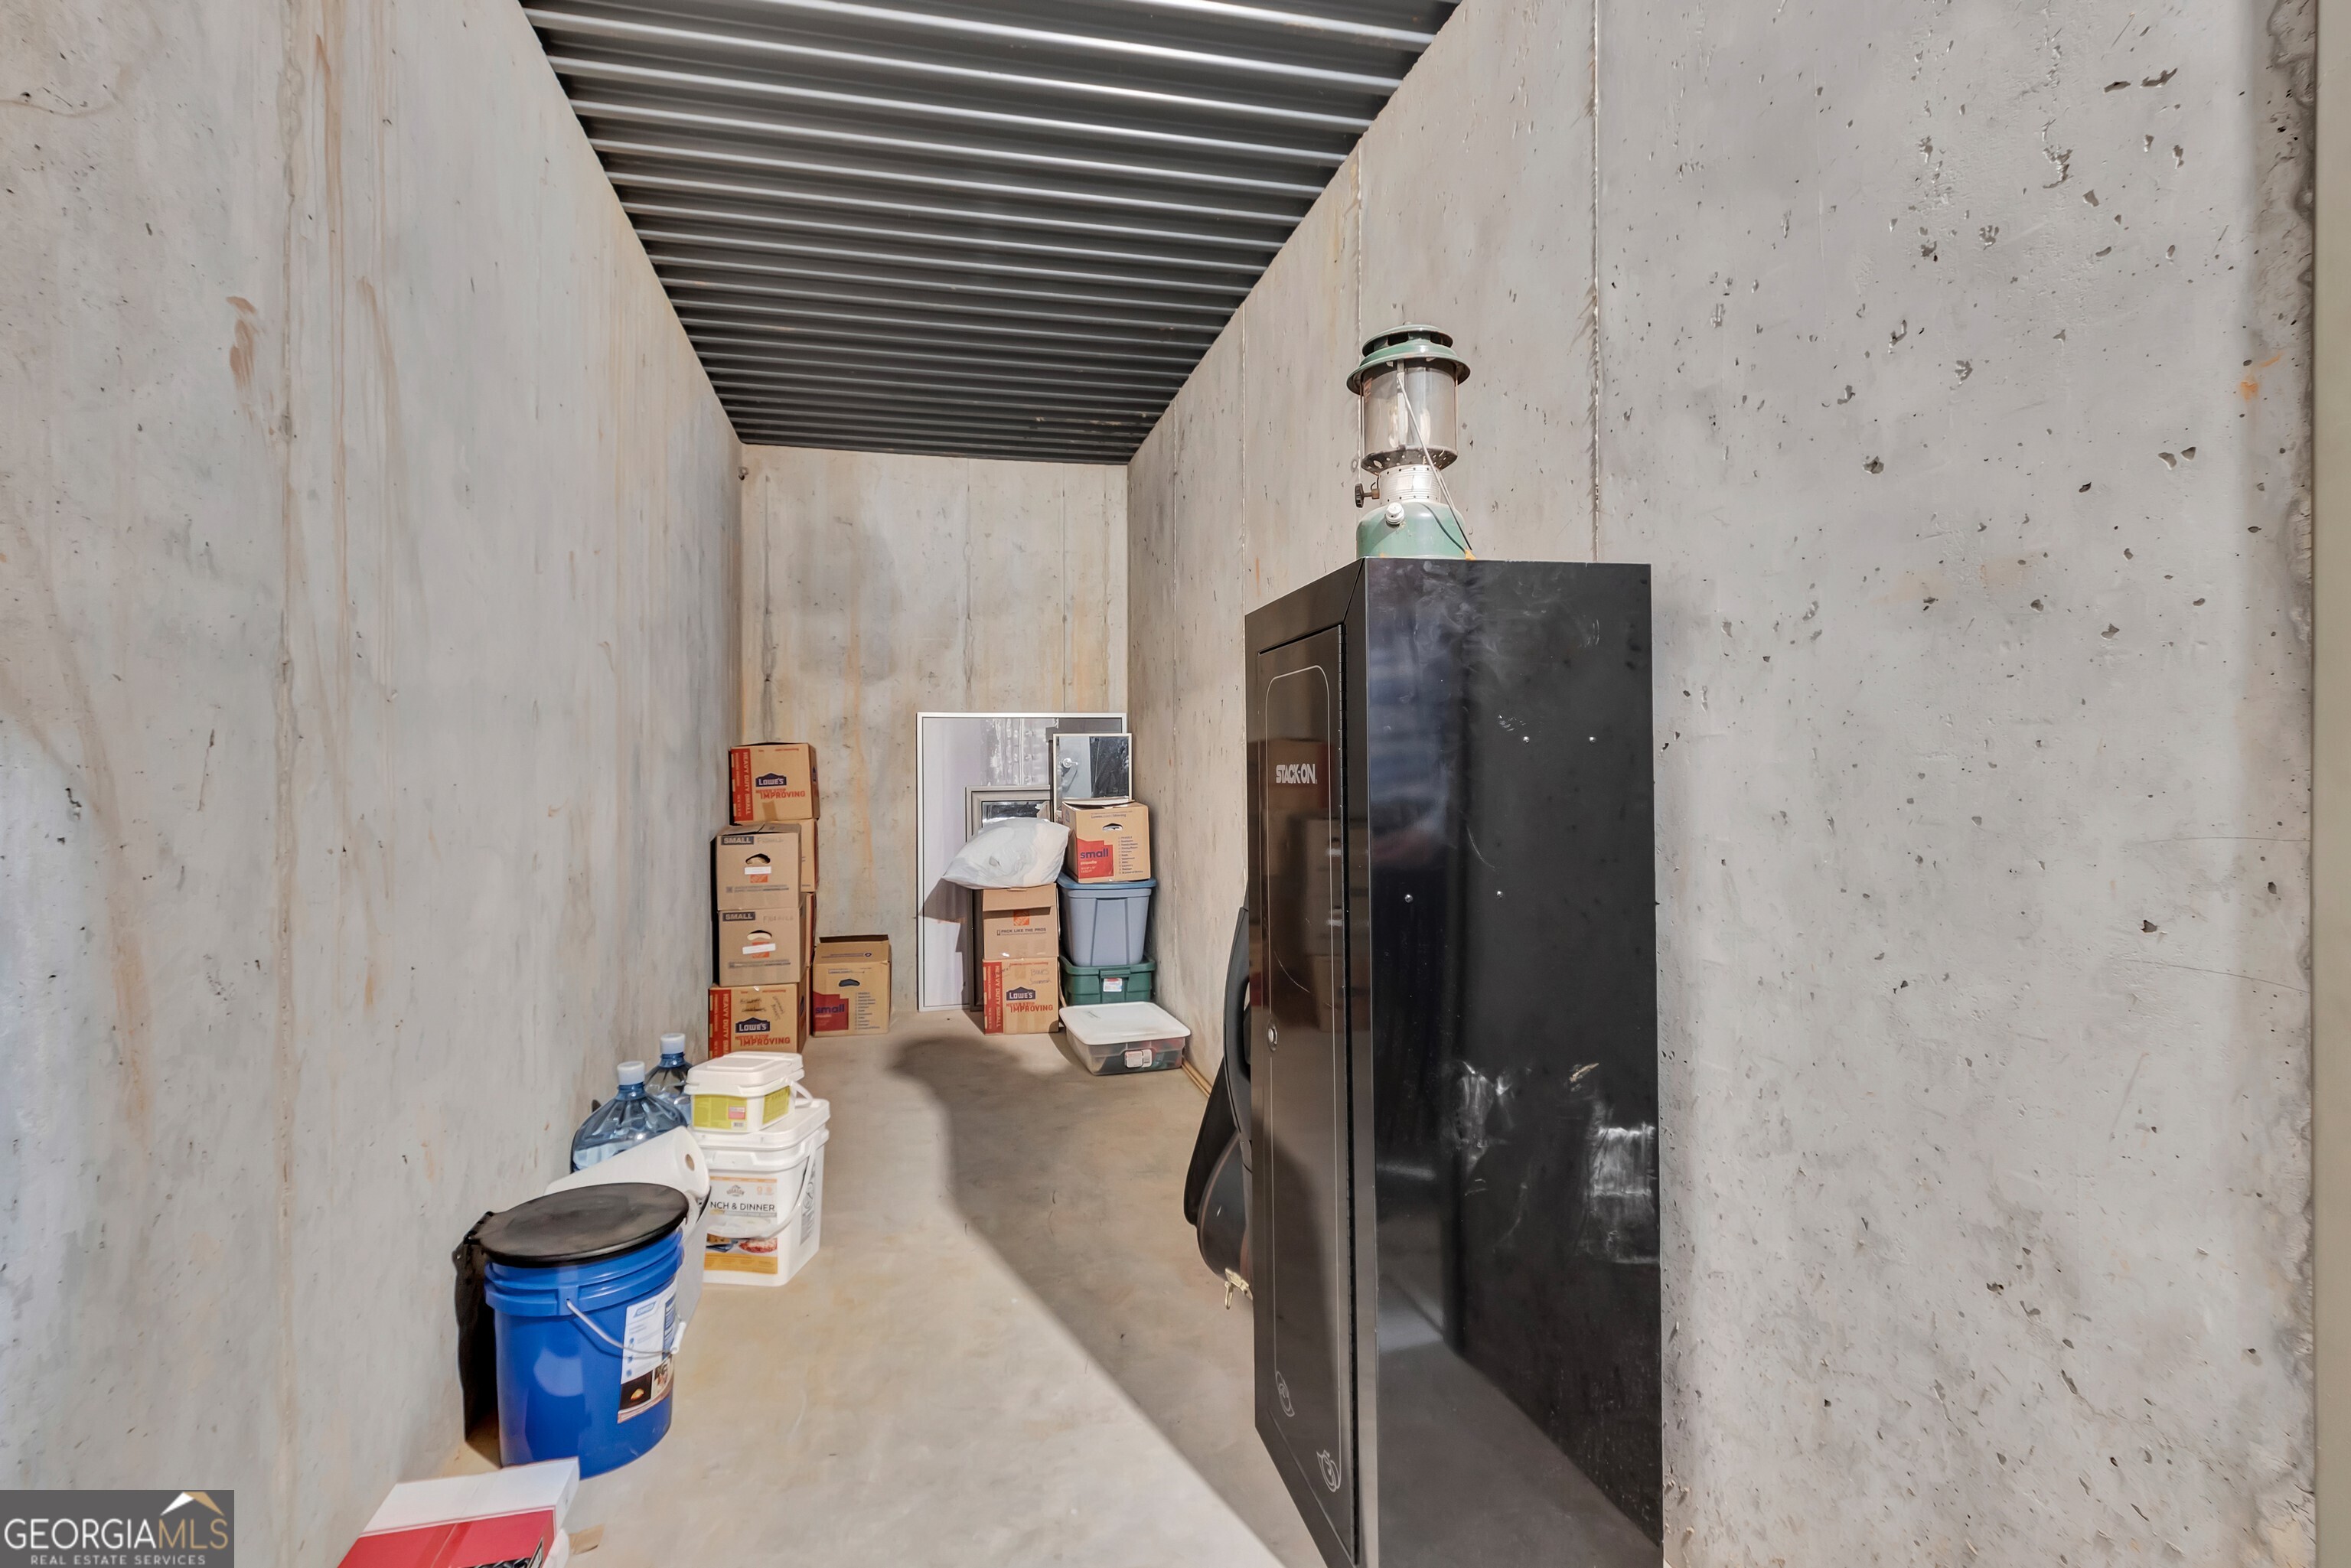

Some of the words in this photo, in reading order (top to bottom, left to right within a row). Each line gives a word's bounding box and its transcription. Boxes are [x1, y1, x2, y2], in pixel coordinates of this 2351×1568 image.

[1276, 763, 1316, 784] STACK-ON
[758, 777, 784, 786] LOWE'S
[760, 791, 806, 799] IMPROVING
[1080, 848, 1109, 859] small
[725, 912, 754, 921] SMALL
[815, 1004, 845, 1014] small
[1010, 1004, 1053, 1013] IMPROVING
[739, 1023, 767, 1032] LOWE'S
[739, 1037, 791, 1047] IMPROVING
[731, 1201, 738, 1210] &
[739, 1203, 775, 1211] DINNER
